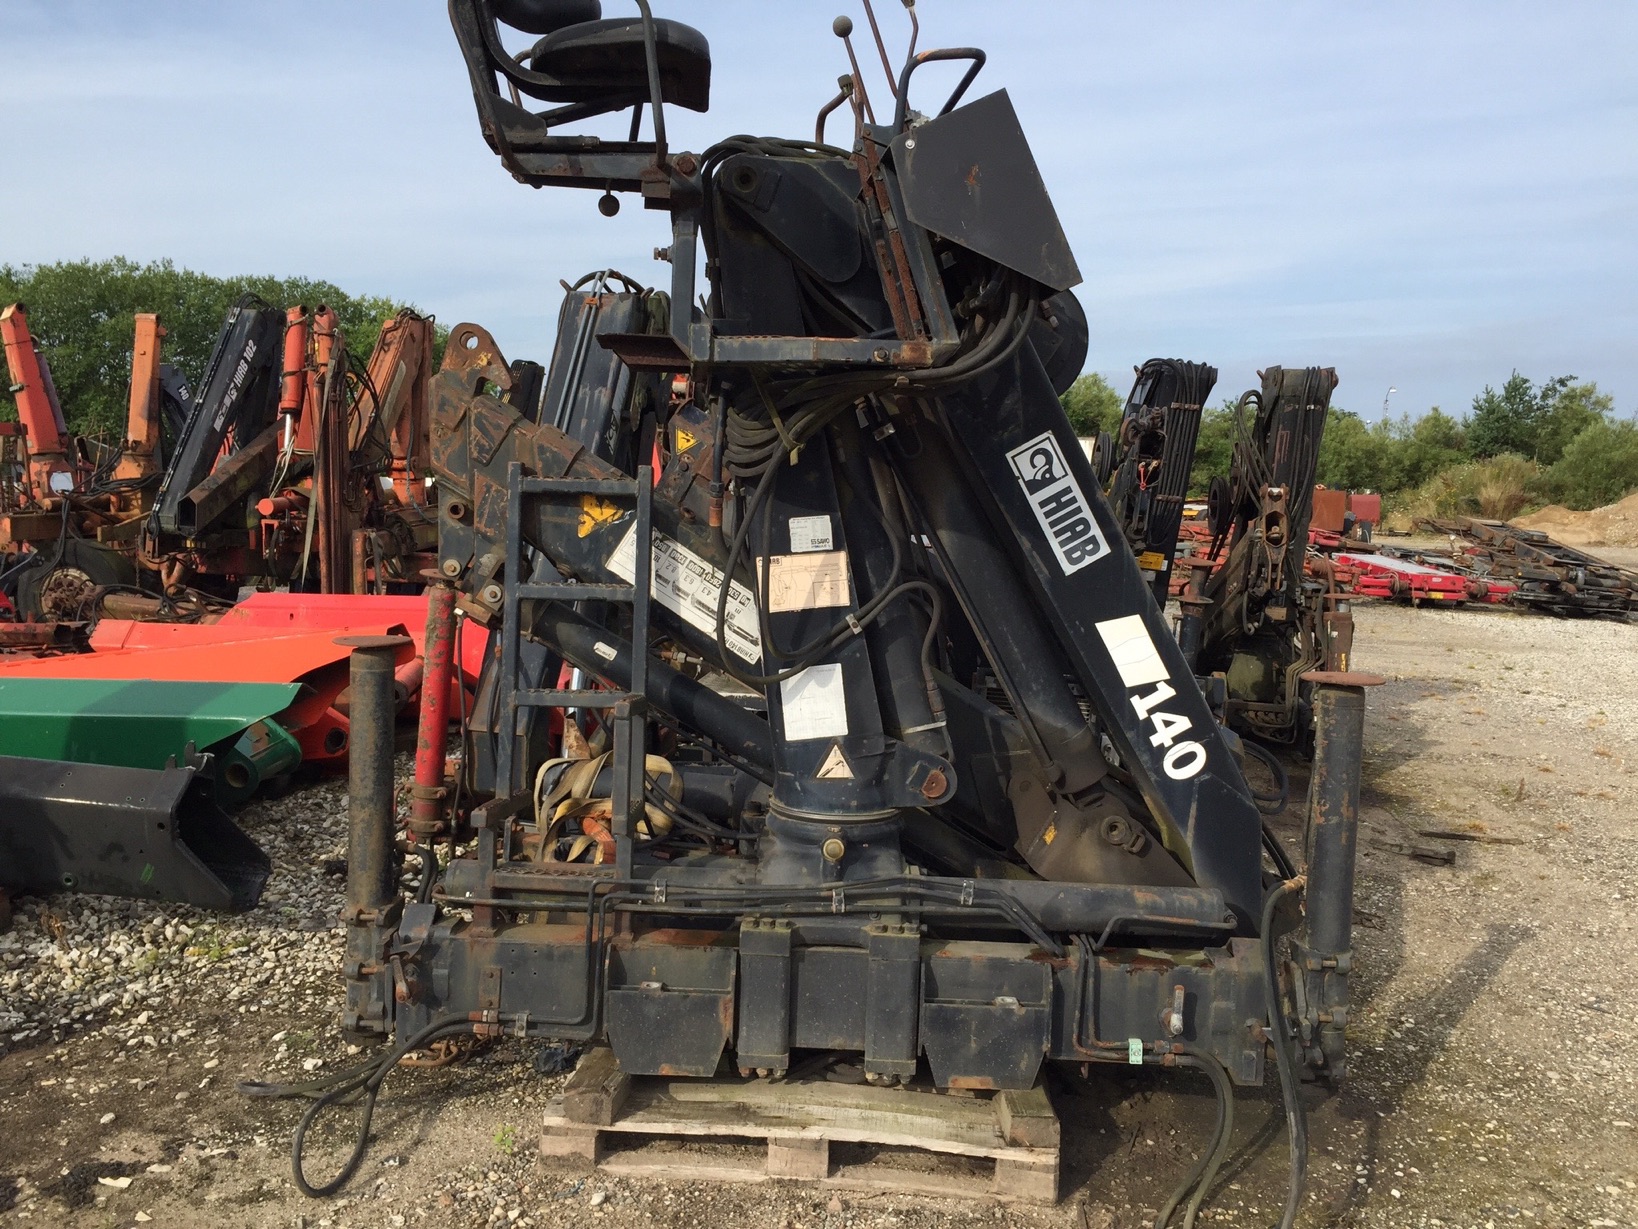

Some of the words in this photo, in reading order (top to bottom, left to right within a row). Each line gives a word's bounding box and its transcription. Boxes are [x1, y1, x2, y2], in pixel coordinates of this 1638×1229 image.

[233, 359, 248, 387] HIAB
[243, 340, 257, 362] 102
[178, 385, 190, 401] 140
[1038, 484, 1102, 567] HIAB
[728, 641, 738, 652] 140
[737, 646, 749, 658] HIAB
[1130, 681, 1207, 780] 140
